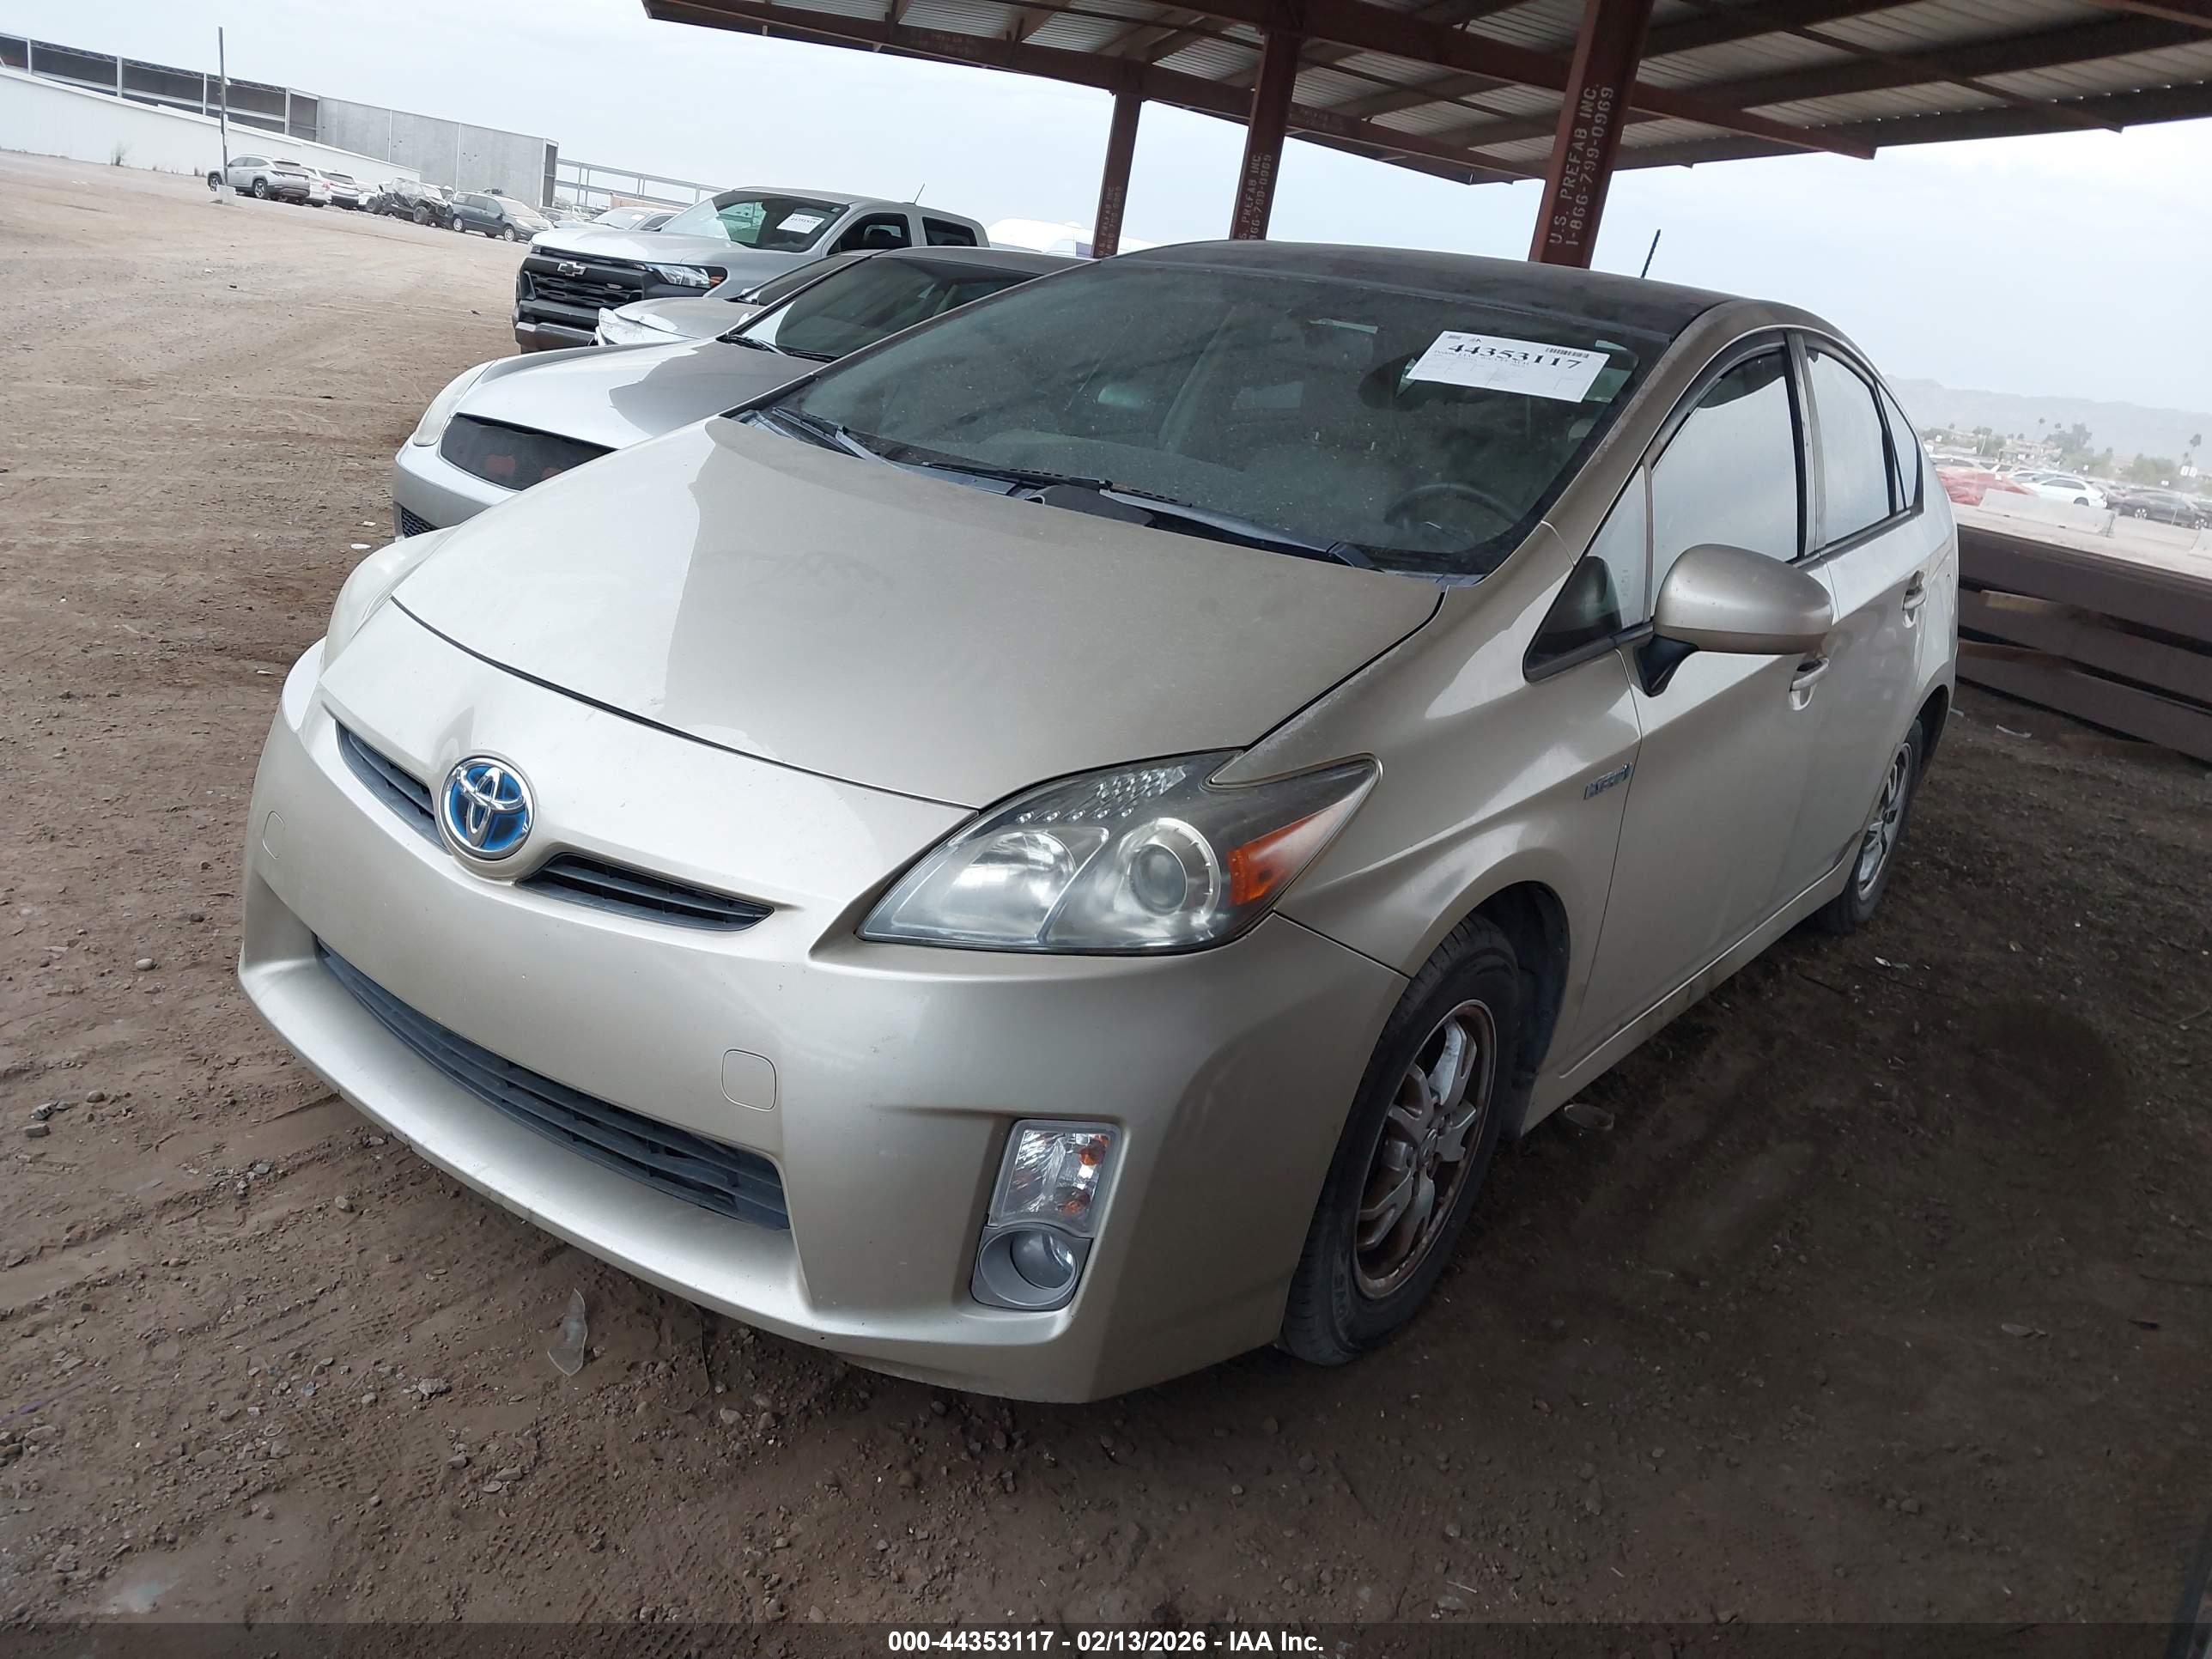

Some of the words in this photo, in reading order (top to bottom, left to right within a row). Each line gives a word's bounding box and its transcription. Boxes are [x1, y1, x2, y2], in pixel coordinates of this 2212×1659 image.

[1548, 210, 1569, 244] U.S.
[1559, 128, 1588, 200] PREFAB
[1565, 87, 1613, 246] 1-866-799-0969
[1447, 343, 1583, 369] 44353117
